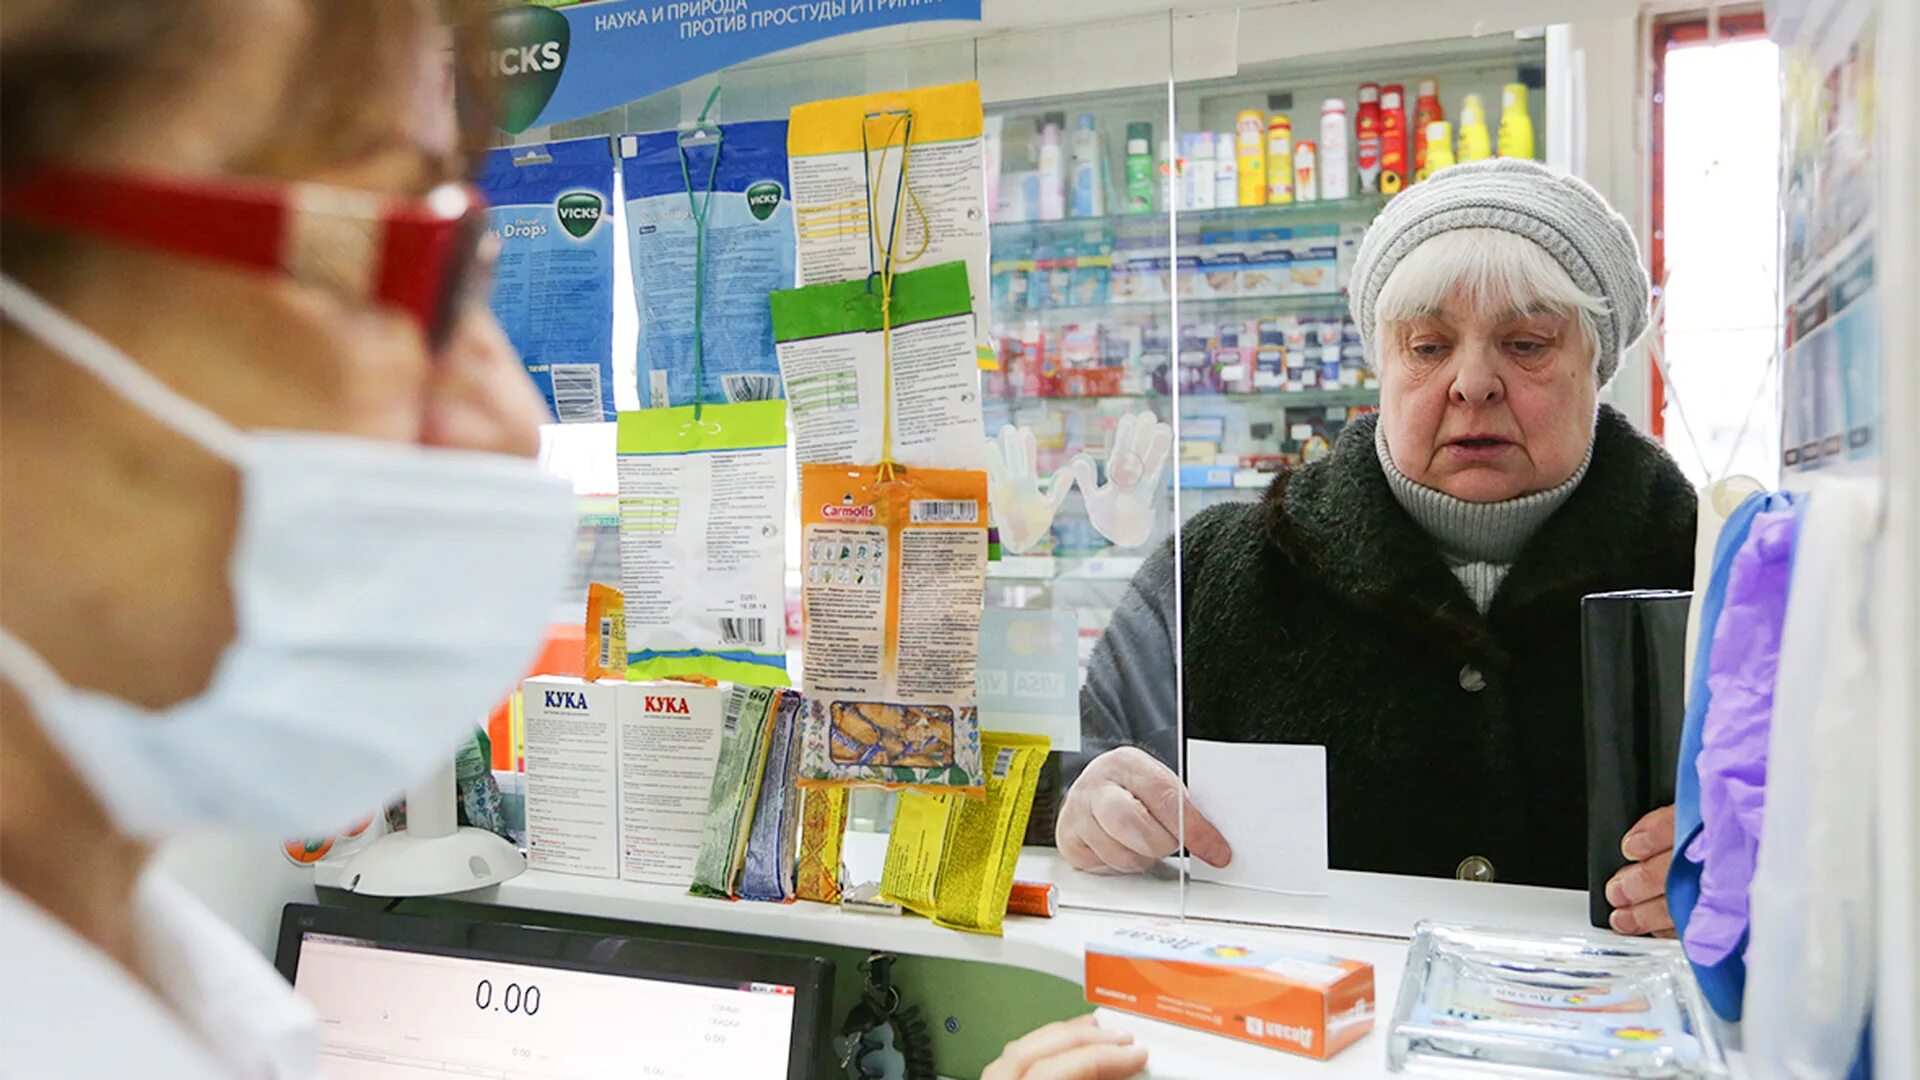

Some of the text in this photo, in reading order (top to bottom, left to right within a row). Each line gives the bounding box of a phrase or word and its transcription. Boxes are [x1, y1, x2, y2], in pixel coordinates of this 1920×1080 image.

[595, 0, 748, 32] НАУКА И ПРИРОДА
[680, 13, 748, 39] ПРОТИВ
[750, 0, 846, 29] ПРОСТУДЫ
[851, 0, 864, 15] И
[489, 41, 562, 78] ICKS
[749, 194, 778, 206] VICKS
[559, 207, 599, 219] VICKS
[504, 223, 548, 240] Drops
[545, 690, 588, 710] КУКА
[644, 696, 690, 714] КУКА
[476, 979, 541, 1016] 0.00
